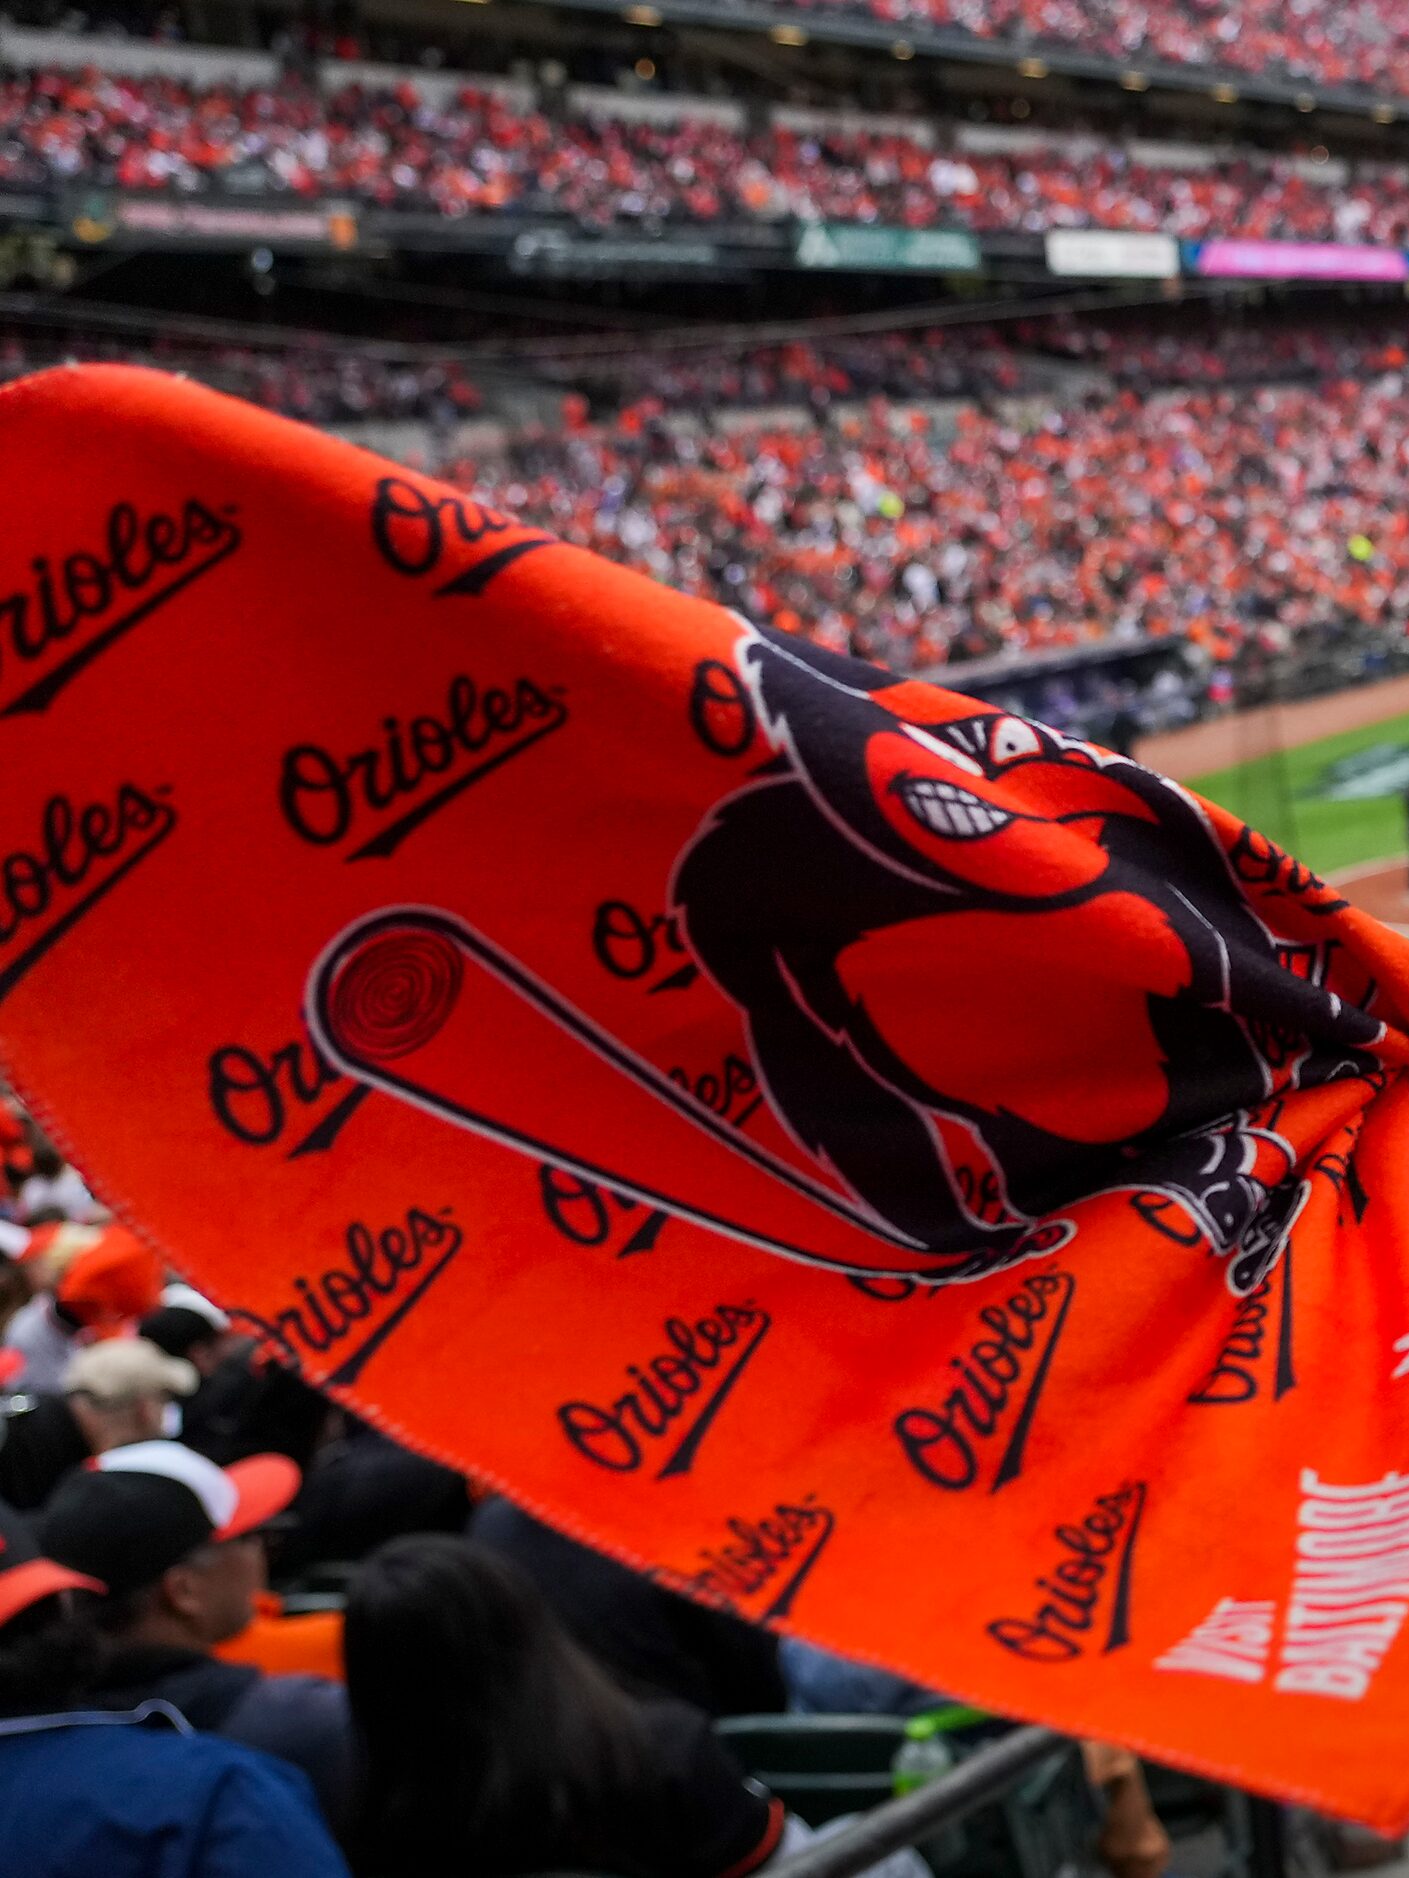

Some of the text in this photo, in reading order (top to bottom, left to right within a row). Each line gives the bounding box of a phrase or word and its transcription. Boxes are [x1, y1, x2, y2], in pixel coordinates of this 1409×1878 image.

[0, 499, 238, 695] rioles
[280, 674, 560, 852] Orioles
[557, 1304, 765, 1475] Orioles
[891, 1272, 1070, 1490] Orioles
[985, 1482, 1140, 1661] Orioles
[1153, 1596, 1276, 1683] VISIT
